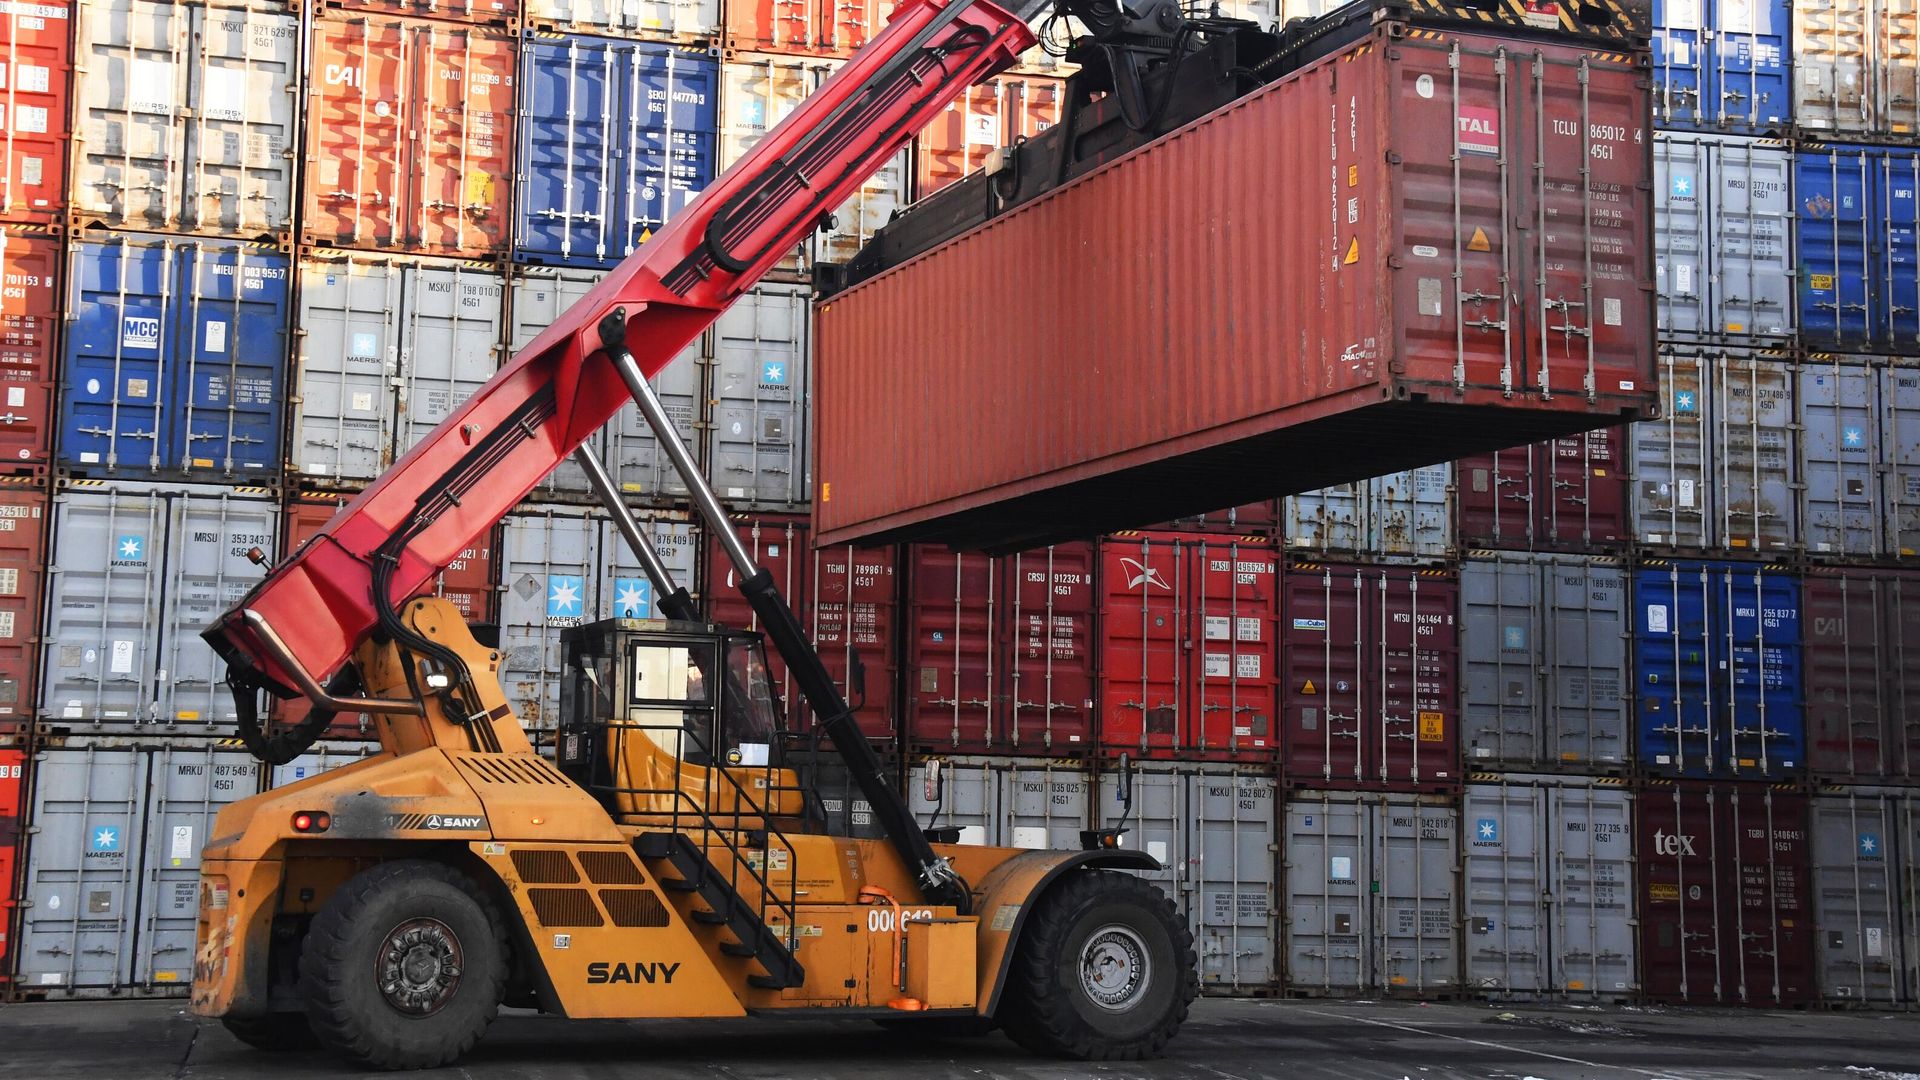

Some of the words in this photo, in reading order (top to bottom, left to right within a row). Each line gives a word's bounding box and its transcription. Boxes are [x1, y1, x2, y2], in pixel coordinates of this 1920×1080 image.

[221, 22, 243, 34] MSKU
[254, 25, 268, 36] 921
[271, 27, 286, 38] 629
[288, 28, 293, 39] 6
[254, 37, 273, 48] 45G1
[325, 64, 361, 87] CAI
[440, 70, 461, 81] CAXU
[505, 75, 512, 87] 3
[471, 84, 490, 96] 45G1
[648, 90, 666, 100] SEKU
[672, 92, 698, 104] 447778
[648, 103, 666, 112] 45G1
[1458, 118, 1495, 135] TAL
[1553, 120, 1577, 136] TCLU
[1590, 124, 1626, 141] 865012
[1634, 128, 1642, 143] 4
[1590, 144, 1613, 160] 45G1
[1560, 184, 1576, 192] GROSS
[1728, 180, 1746, 189] MRSU
[1753, 182, 1764, 190] 377
[1766, 182, 1778, 192] 418
[1782, 184, 1786, 192] 3
[1753, 190, 1768, 199] 45G1
[1894, 190, 1912, 198] AMFU
[213, 264, 234, 276] MIEU
[244, 267, 260, 278] 003
[262, 268, 278, 279] 955
[6, 274, 38, 286] 701153
[45, 277, 52, 288] 8
[244, 279, 264, 290] 45G1
[3, 288, 26, 298] 45G1
[428, 282, 451, 293] MSKU
[464, 286, 476, 295] 198
[479, 286, 493, 296] 010
[495, 288, 500, 297] 0
[462, 298, 480, 308] 45G1
[125, 320, 158, 336] MCC
[346, 356, 382, 364] MAERSK
[758, 384, 790, 392] MAERSK
[1898, 379, 1917, 388] MRKU
[1733, 388, 1751, 397] MRKU
[1759, 390, 1770, 398] 571
[1772, 390, 1784, 398] 486
[1786, 391, 1790, 400] 9
[1760, 401, 1775, 409] 45G1
[194, 532, 218, 543] MRSU
[232, 534, 246, 544] 353
[250, 534, 264, 544] 343
[267, 535, 272, 544] 7
[657, 535, 671, 545] 876
[672, 536, 687, 545] 409
[690, 537, 694, 546] 0
[657, 548, 675, 557] 45G1
[110, 560, 148, 568] MAERSK
[1211, 561, 1230, 570] HASU
[1238, 562, 1264, 572] 496625
[1269, 564, 1274, 572] 7
[827, 564, 845, 574] TGHU
[856, 565, 883, 575] 789861
[855, 577, 874, 587] 45G1
[1028, 572, 1046, 582] CRSU
[1054, 574, 1080, 584] 912324
[1086, 574, 1092, 584] 0
[1564, 576, 1583, 586] MSKU
[1592, 579, 1604, 588] 189
[1606, 580, 1618, 588] 990
[1618, 580, 1623, 589] 9
[1054, 586, 1072, 596] 45G1
[1592, 593, 1607, 601] 45G1
[1736, 608, 1754, 617] MRKU
[1764, 608, 1776, 618] 255
[1777, 610, 1789, 618] 837
[1791, 610, 1796, 619] 7
[1393, 614, 1410, 623] MTSU
[1416, 615, 1442, 624] 961464
[1448, 616, 1453, 625] 8
[1764, 618, 1779, 628] 45G1
[1418, 626, 1434, 636] 45G1
[1814, 617, 1843, 636] CAI
[14, 768, 19, 777] 9
[178, 766, 203, 776] MRKU
[214, 766, 230, 776] 487
[232, 767, 248, 776] 549
[250, 767, 256, 776] 4
[214, 780, 234, 790] 45G1
[1024, 783, 1043, 793] MSKU
[1052, 784, 1064, 792] 035
[1066, 784, 1079, 793] 025
[1082, 784, 1087, 793] 7
[1210, 788, 1229, 797] MSKU
[1239, 789, 1252, 798] 052
[1253, 790, 1266, 798] 602
[1268, 790, 1273, 798] 7
[1052, 796, 1068, 804] 45G1
[1238, 800, 1255, 810] 45G1
[444, 818, 481, 827] SANY
[852, 814, 870, 824] 45G1
[1392, 818, 1412, 828] MRKU
[1422, 818, 1434, 828] 042
[1436, 820, 1448, 828] 618
[1450, 820, 1454, 829] 1
[1567, 822, 1586, 832] MRKU
[1594, 824, 1606, 833] 277
[1608, 824, 1620, 833] 335
[1624, 825, 1629, 834] 9
[1422, 829, 1438, 838] 42G1
[1595, 834, 1611, 842] 45G1
[1773, 830, 1799, 840] 540645
[1654, 828, 1696, 856] tex
[1774, 842, 1792, 852] 45G1
[1744, 876, 1755, 884] TARE
[1650, 884, 1678, 892] CAUTION
[587, 962, 680, 984] SANY
